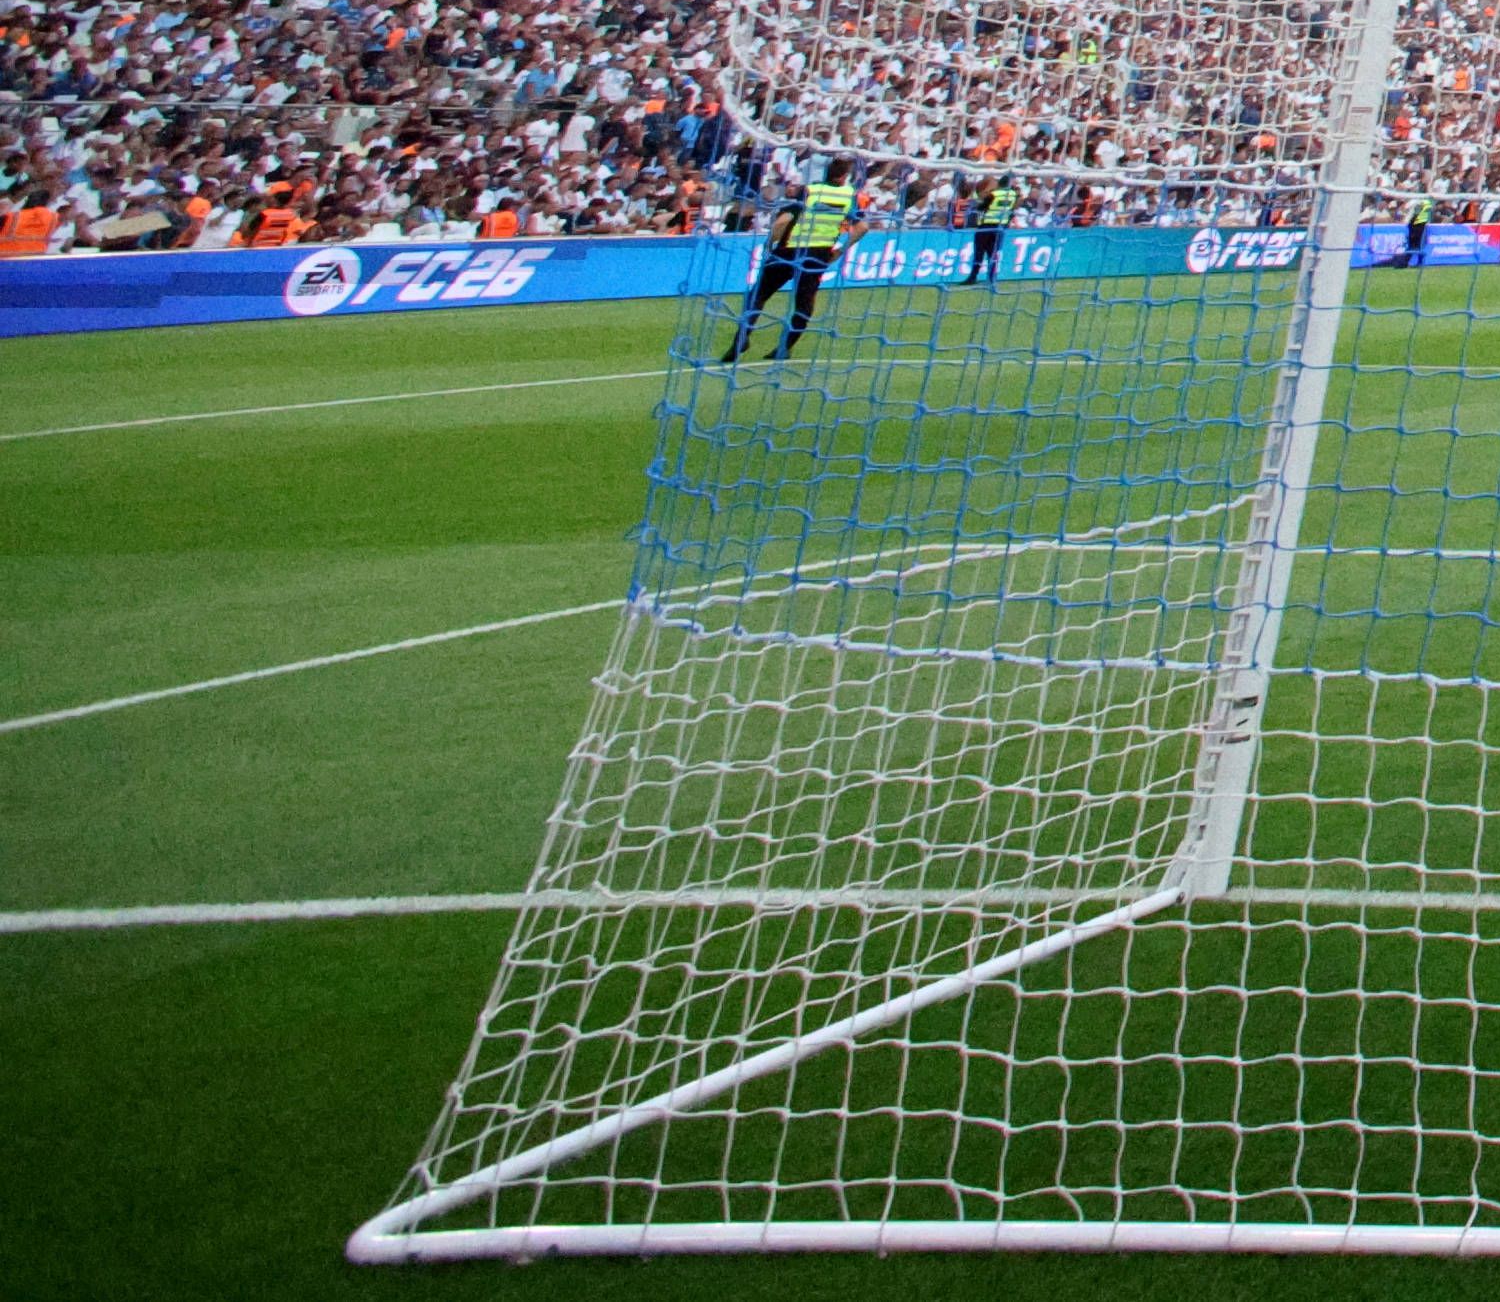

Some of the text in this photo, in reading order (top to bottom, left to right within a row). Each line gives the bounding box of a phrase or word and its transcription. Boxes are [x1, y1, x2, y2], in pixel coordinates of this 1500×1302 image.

[301, 262, 347, 285] EA
[916, 241, 974, 278] est
[296, 283, 345, 297] SPORTS
[350, 246, 555, 305] FC26
